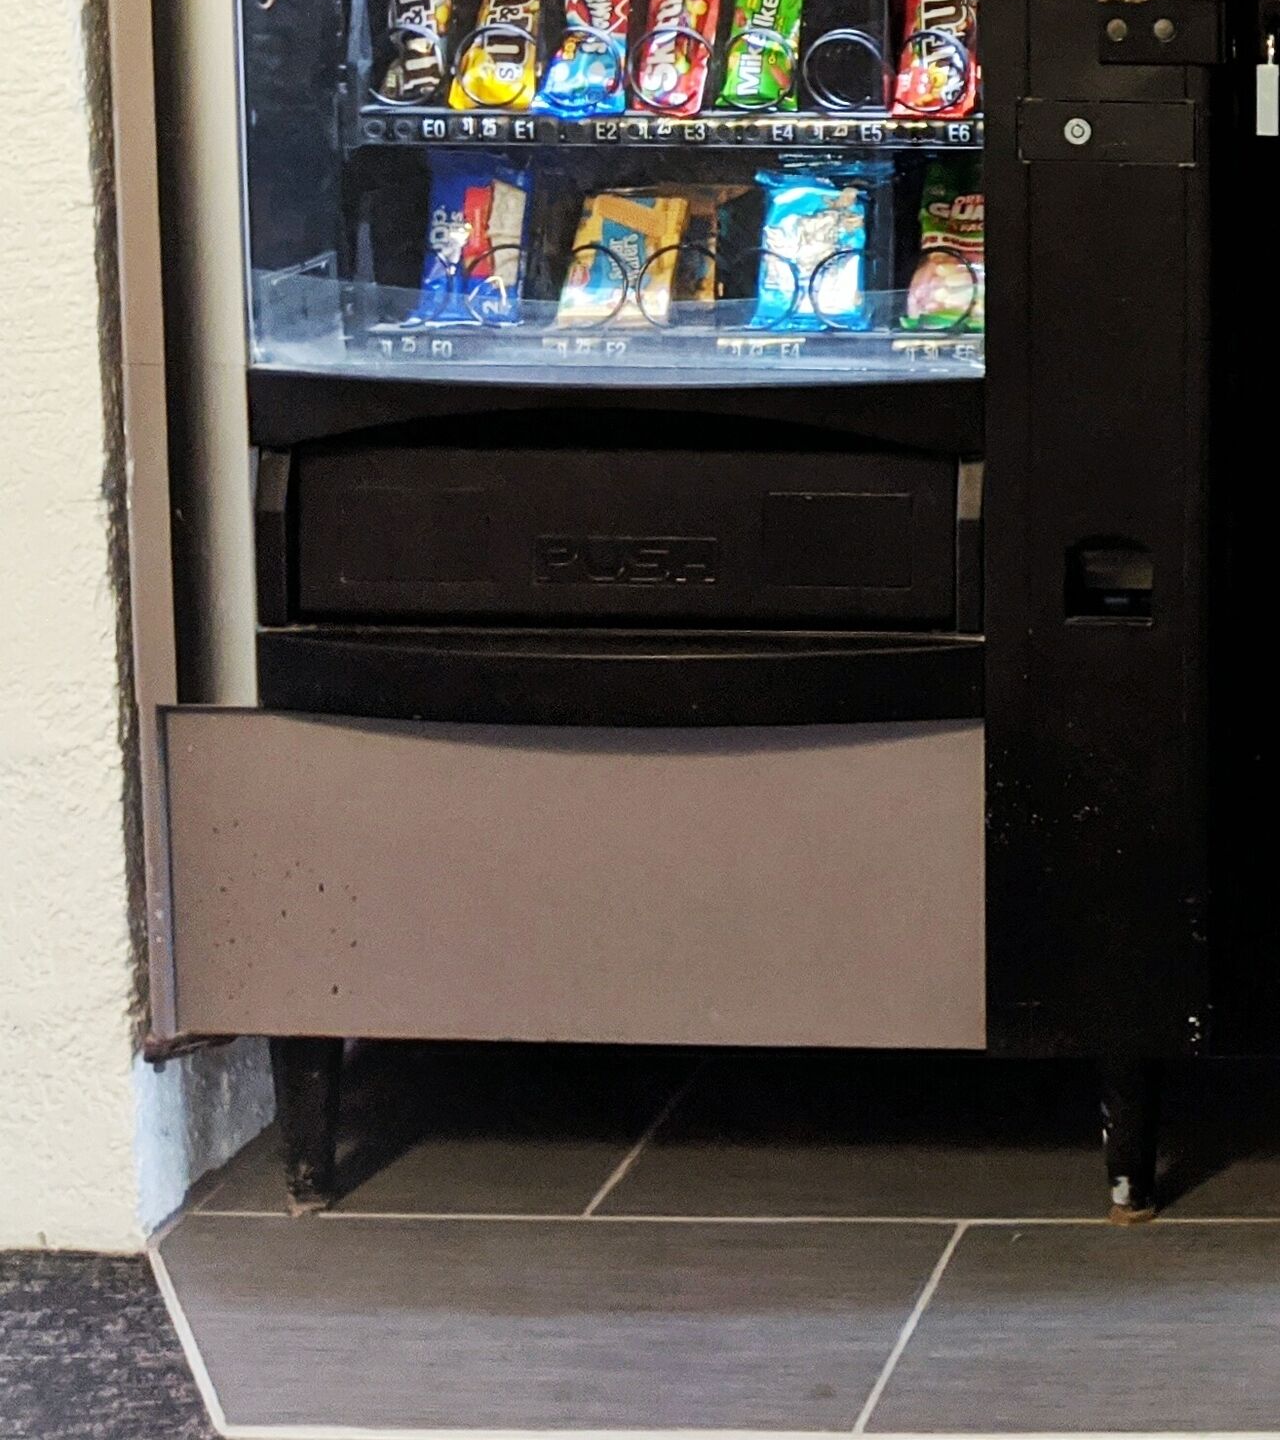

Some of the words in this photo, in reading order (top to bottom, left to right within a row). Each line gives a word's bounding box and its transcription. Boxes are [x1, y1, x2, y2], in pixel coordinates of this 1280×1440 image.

[422, 119, 446, 138] E0
[514, 120, 535, 140] E1
[595, 122, 618, 141] E2
[684, 123, 706, 141] E3
[772, 123, 794, 141] E4
[860, 123, 882, 142] E5
[948, 123, 970, 142] E6
